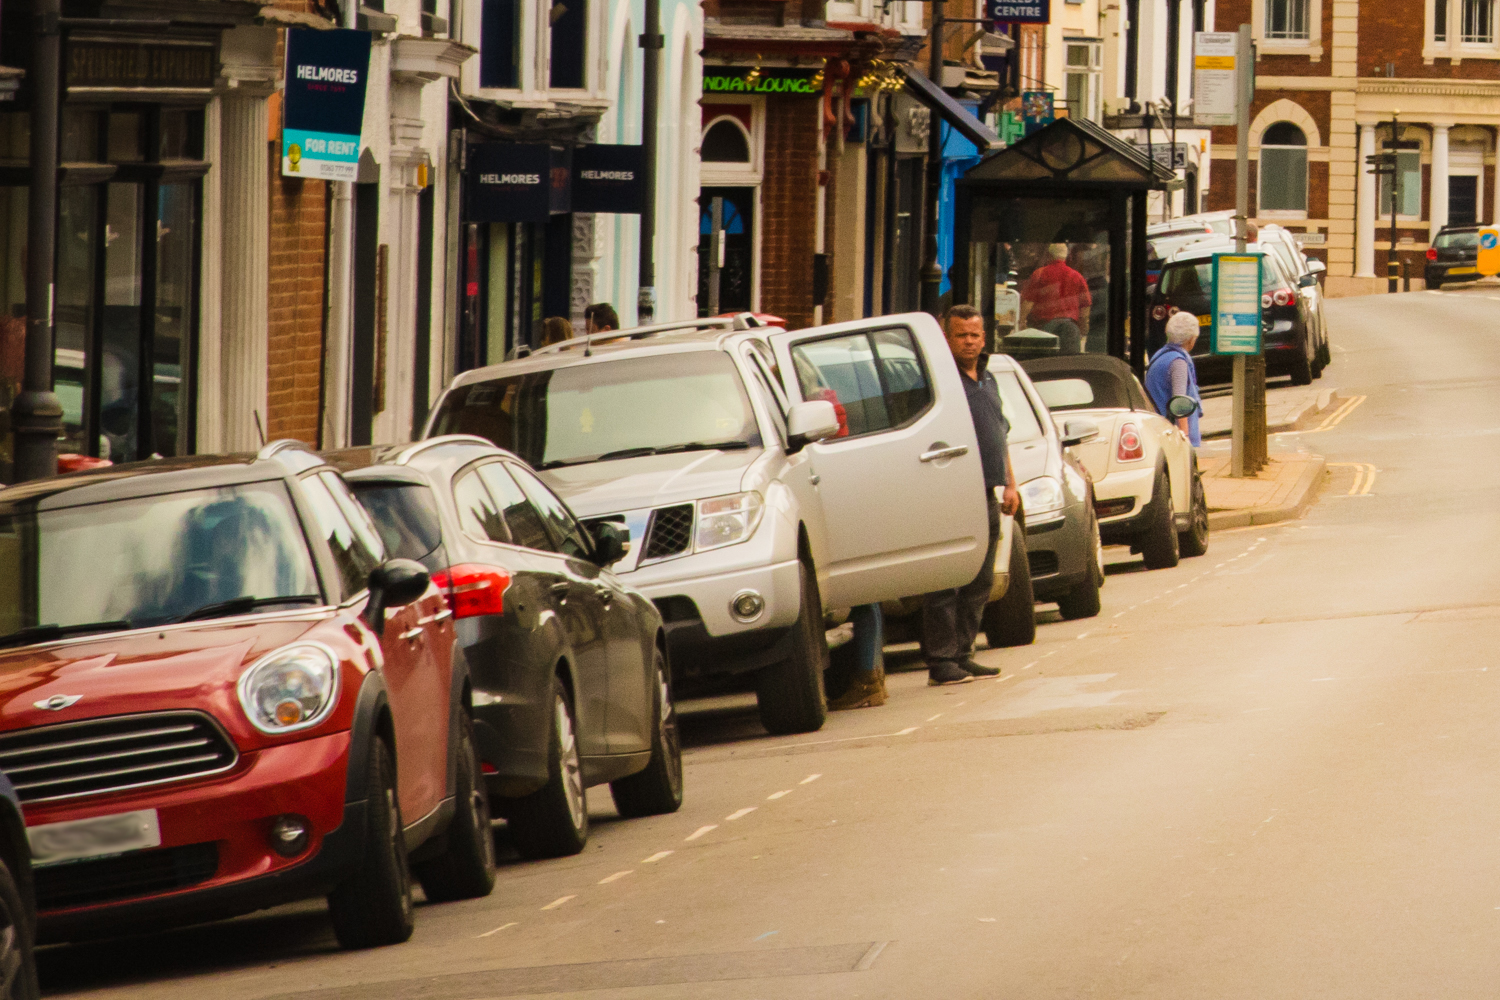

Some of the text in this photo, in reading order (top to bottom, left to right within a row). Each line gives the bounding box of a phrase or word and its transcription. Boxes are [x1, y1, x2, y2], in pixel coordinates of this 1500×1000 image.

[994, 6, 1041, 17] CENTRE
[296, 64, 358, 83] HELMORES
[703, 76, 752, 91] NDIA
[305, 138, 356, 155] FOR RENT
[480, 173, 540, 184] HELMORES
[581, 169, 634, 180] HELMORES
